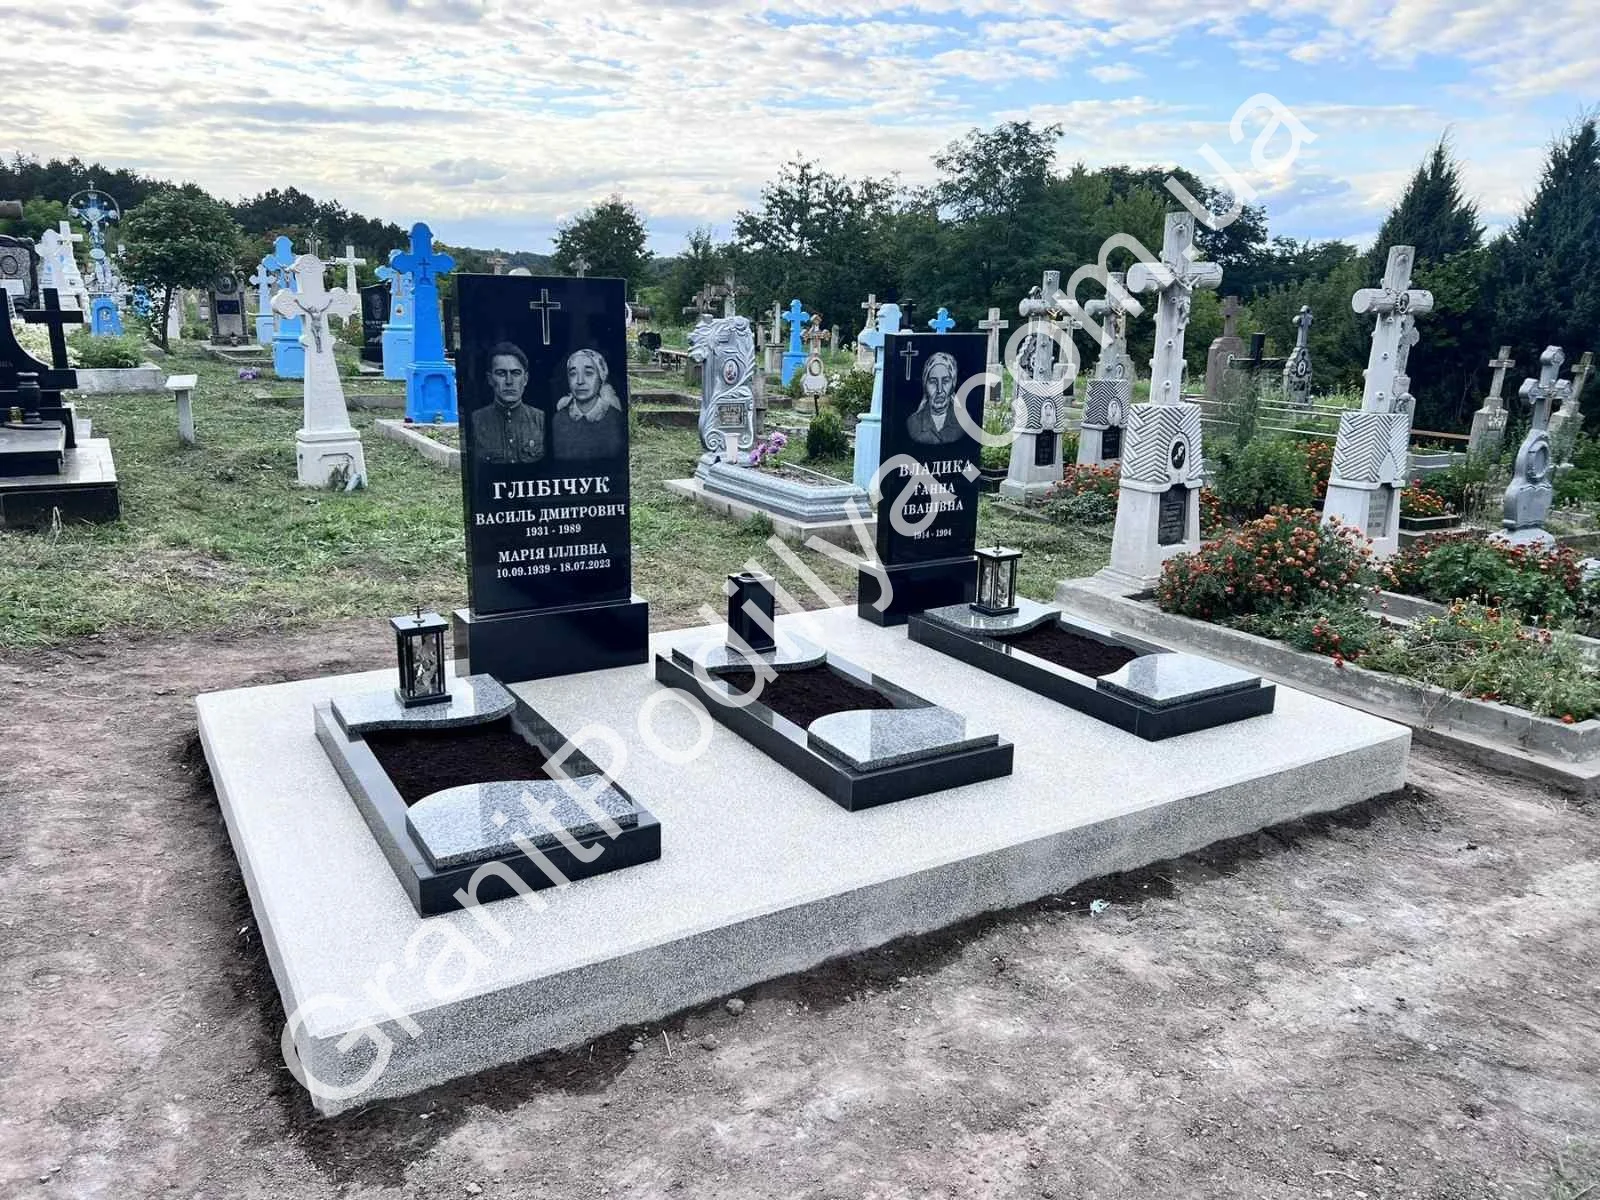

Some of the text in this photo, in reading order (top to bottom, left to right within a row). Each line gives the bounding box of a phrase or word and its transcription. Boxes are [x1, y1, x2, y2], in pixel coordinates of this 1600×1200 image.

[899, 459, 973, 477] ВЛАДИКА
[492, 476, 610, 500] ГЛІБІЧУК
[475, 504, 626, 526] ВАСИЛЬ ДМИТРОВИЧ
[903, 500, 964, 515] ІВАНІВНА
[525, 526, 550, 537] 1931
[558, 523, 582, 535] 1989
[498, 543, 608, 563] МАРІЯ ІЛЛІВНА
[497, 565, 551, 578] 10.09.1939
[559, 559, 611, 573] 18.07.2023
